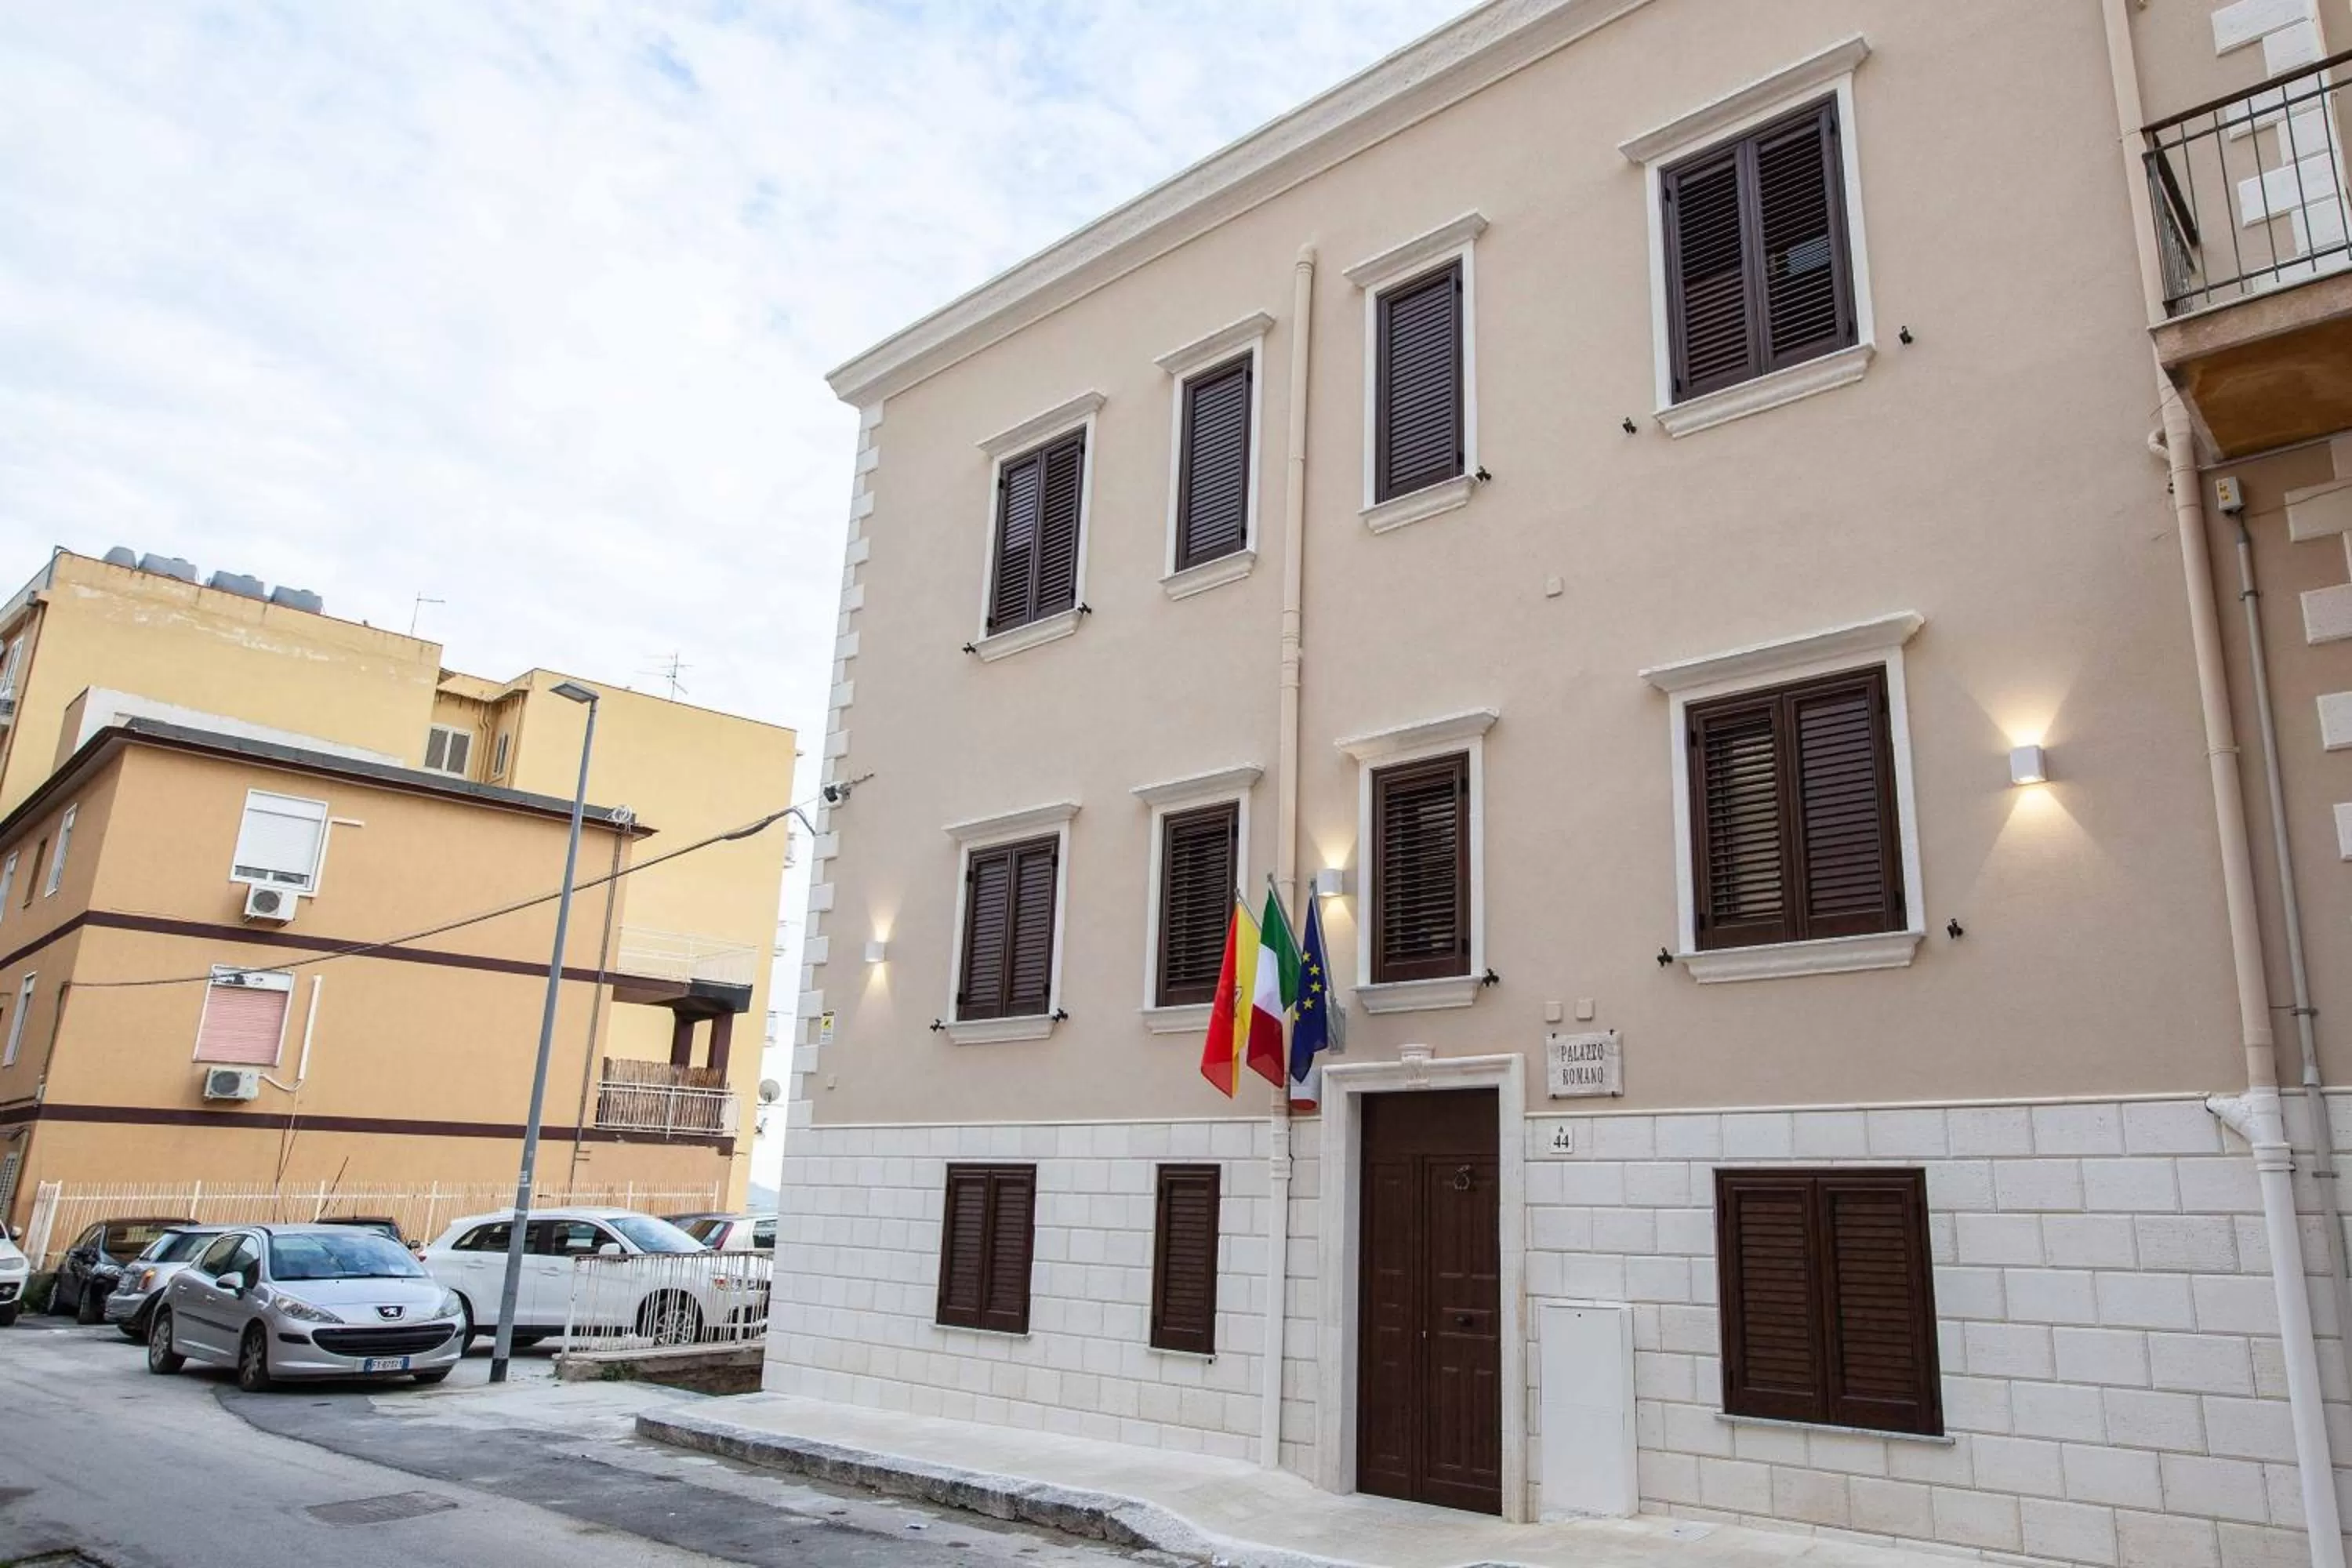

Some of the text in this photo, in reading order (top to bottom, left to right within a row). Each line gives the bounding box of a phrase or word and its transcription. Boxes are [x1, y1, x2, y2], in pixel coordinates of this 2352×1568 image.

[1561, 1043, 1603, 1062] PALAZZO
[1563, 1066, 1603, 1085] ROMANO
[1553, 1134, 1569, 1149] 44
